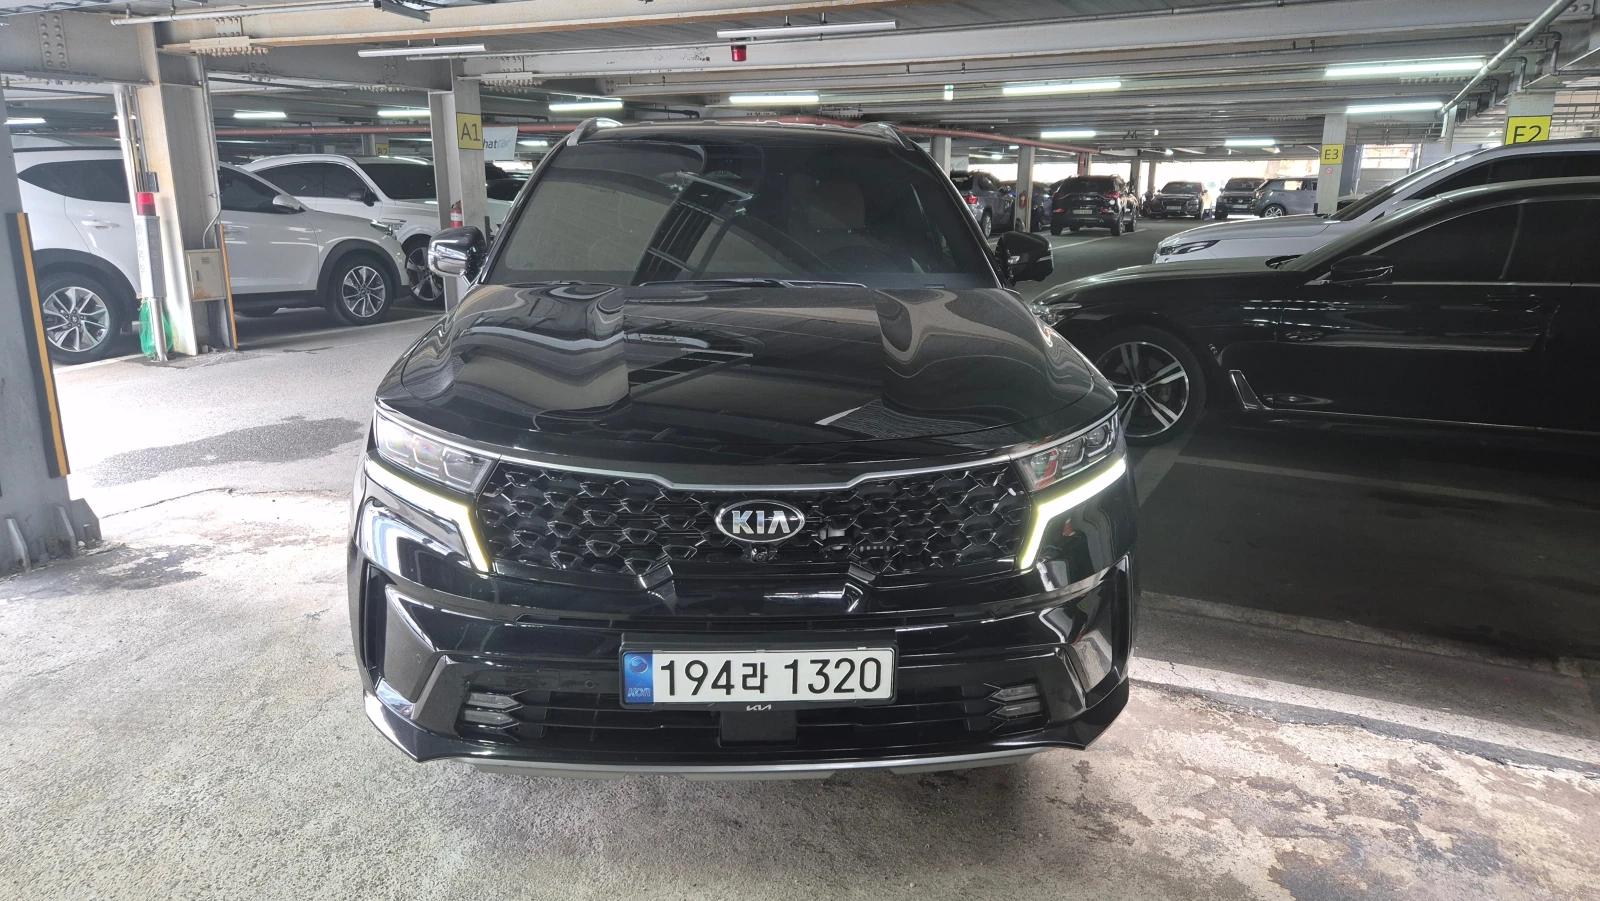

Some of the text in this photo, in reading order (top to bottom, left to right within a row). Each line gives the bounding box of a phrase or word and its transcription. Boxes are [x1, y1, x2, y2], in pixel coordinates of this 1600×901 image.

[460, 122, 481, 141] A1
[483, 138, 510, 149] hatcar
[1324, 148, 1339, 160] E3
[731, 510, 791, 534] KIA
[660, 657, 882, 696] 194라 1320
